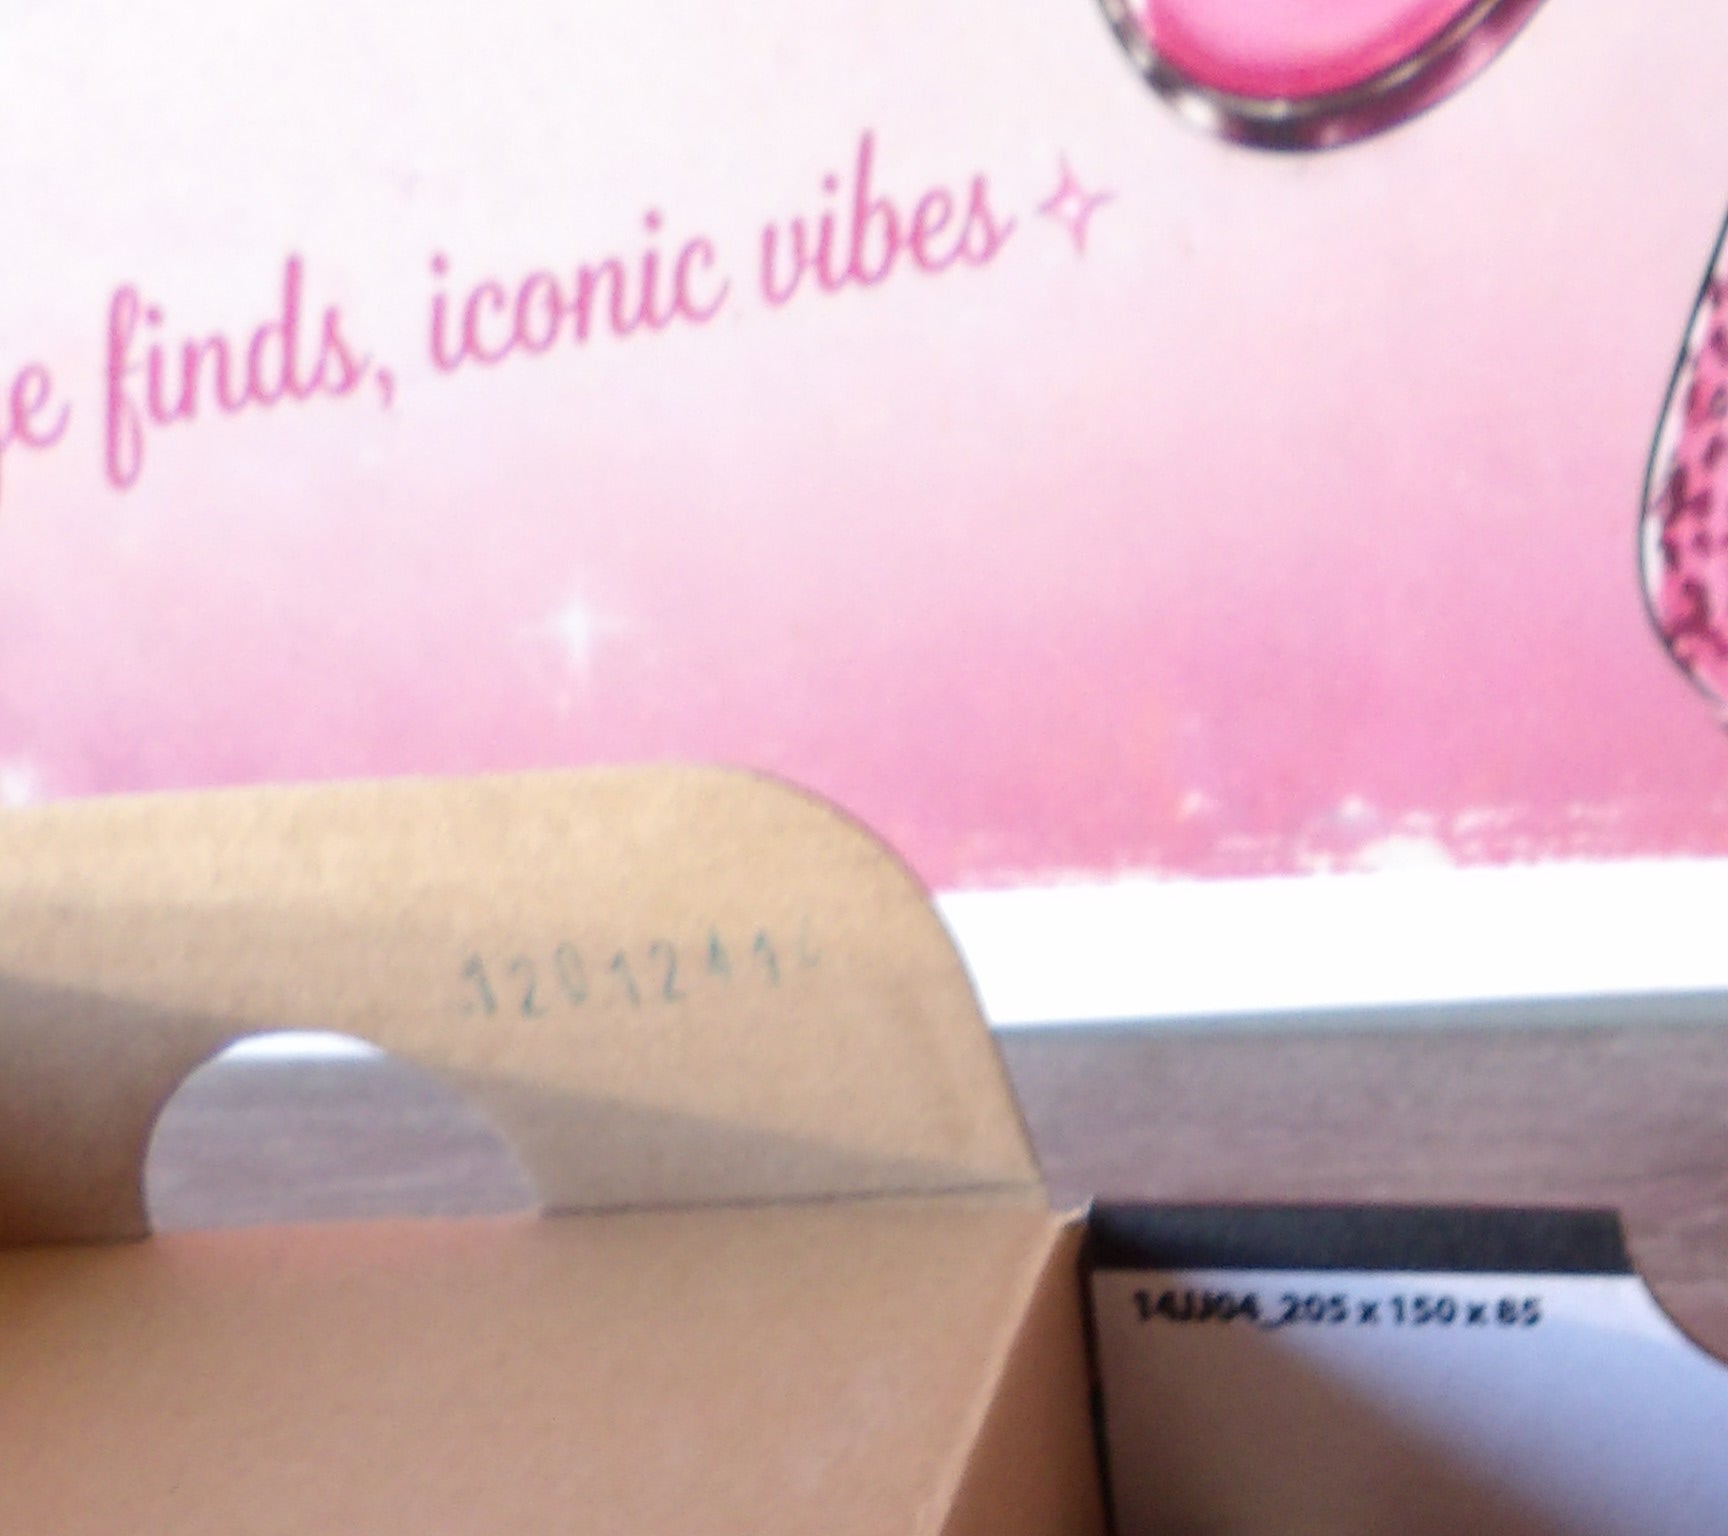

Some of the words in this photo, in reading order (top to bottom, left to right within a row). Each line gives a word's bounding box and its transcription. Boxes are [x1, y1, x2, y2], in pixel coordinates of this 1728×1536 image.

[103, 252, 396, 492] finds,
[428, 208, 729, 374] iconic
[757, 129, 1016, 308] vibes
